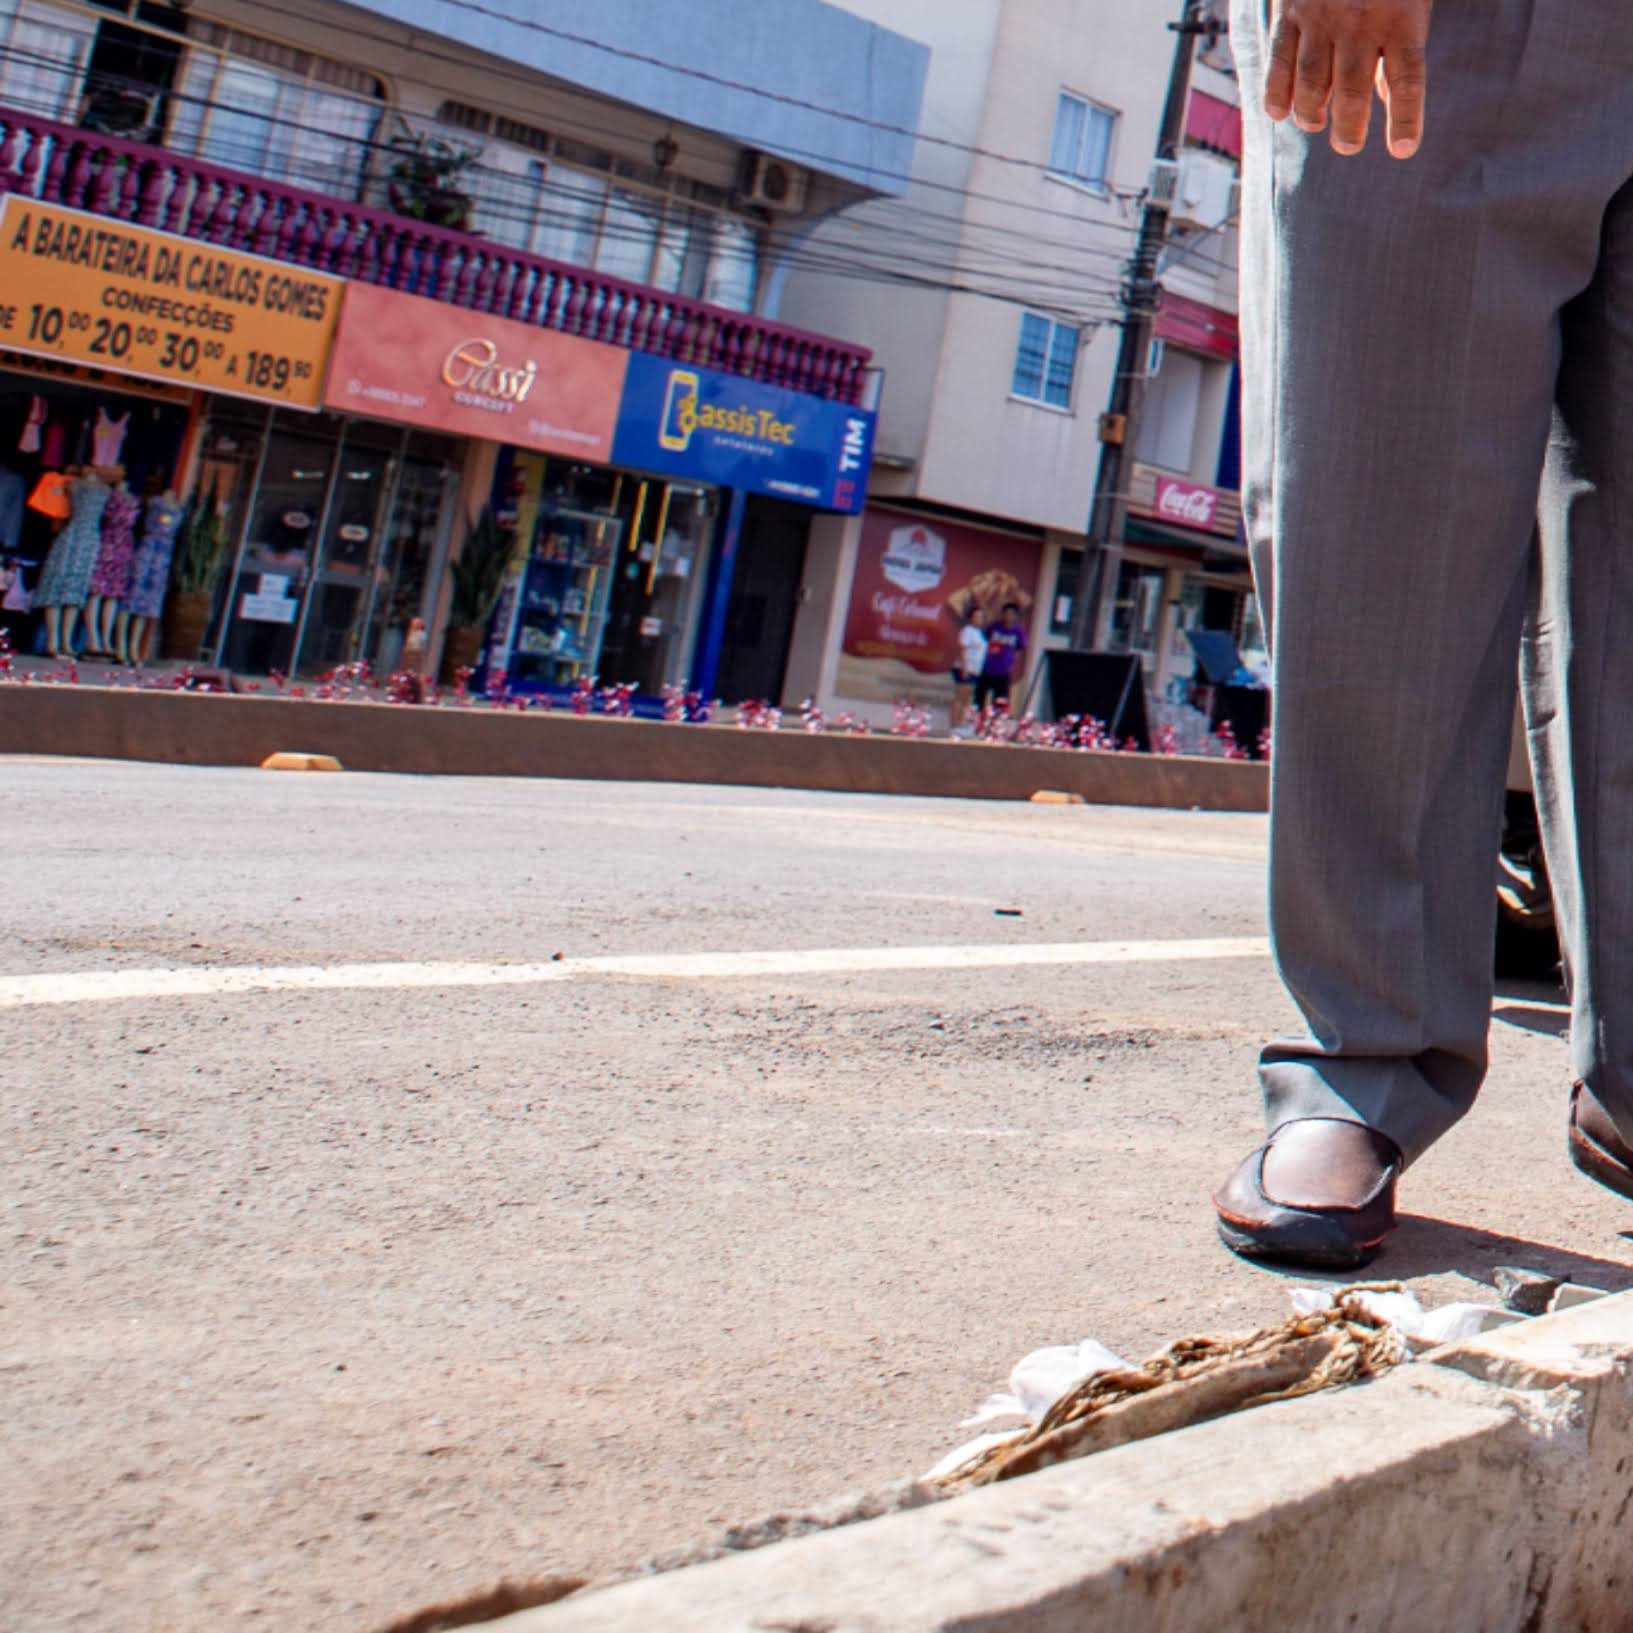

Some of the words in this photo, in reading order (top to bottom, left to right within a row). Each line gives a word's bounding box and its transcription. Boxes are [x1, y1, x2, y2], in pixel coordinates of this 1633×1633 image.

[11, 213, 31, 252] A
[33, 218, 150, 283] BARATEIRA
[152, 246, 182, 289] DA
[185, 254, 261, 305] CARLOS
[264, 276, 328, 321] GOMES
[102, 286, 235, 334] CONFECÇÕES
[839, 418, 867, 472] TIM
